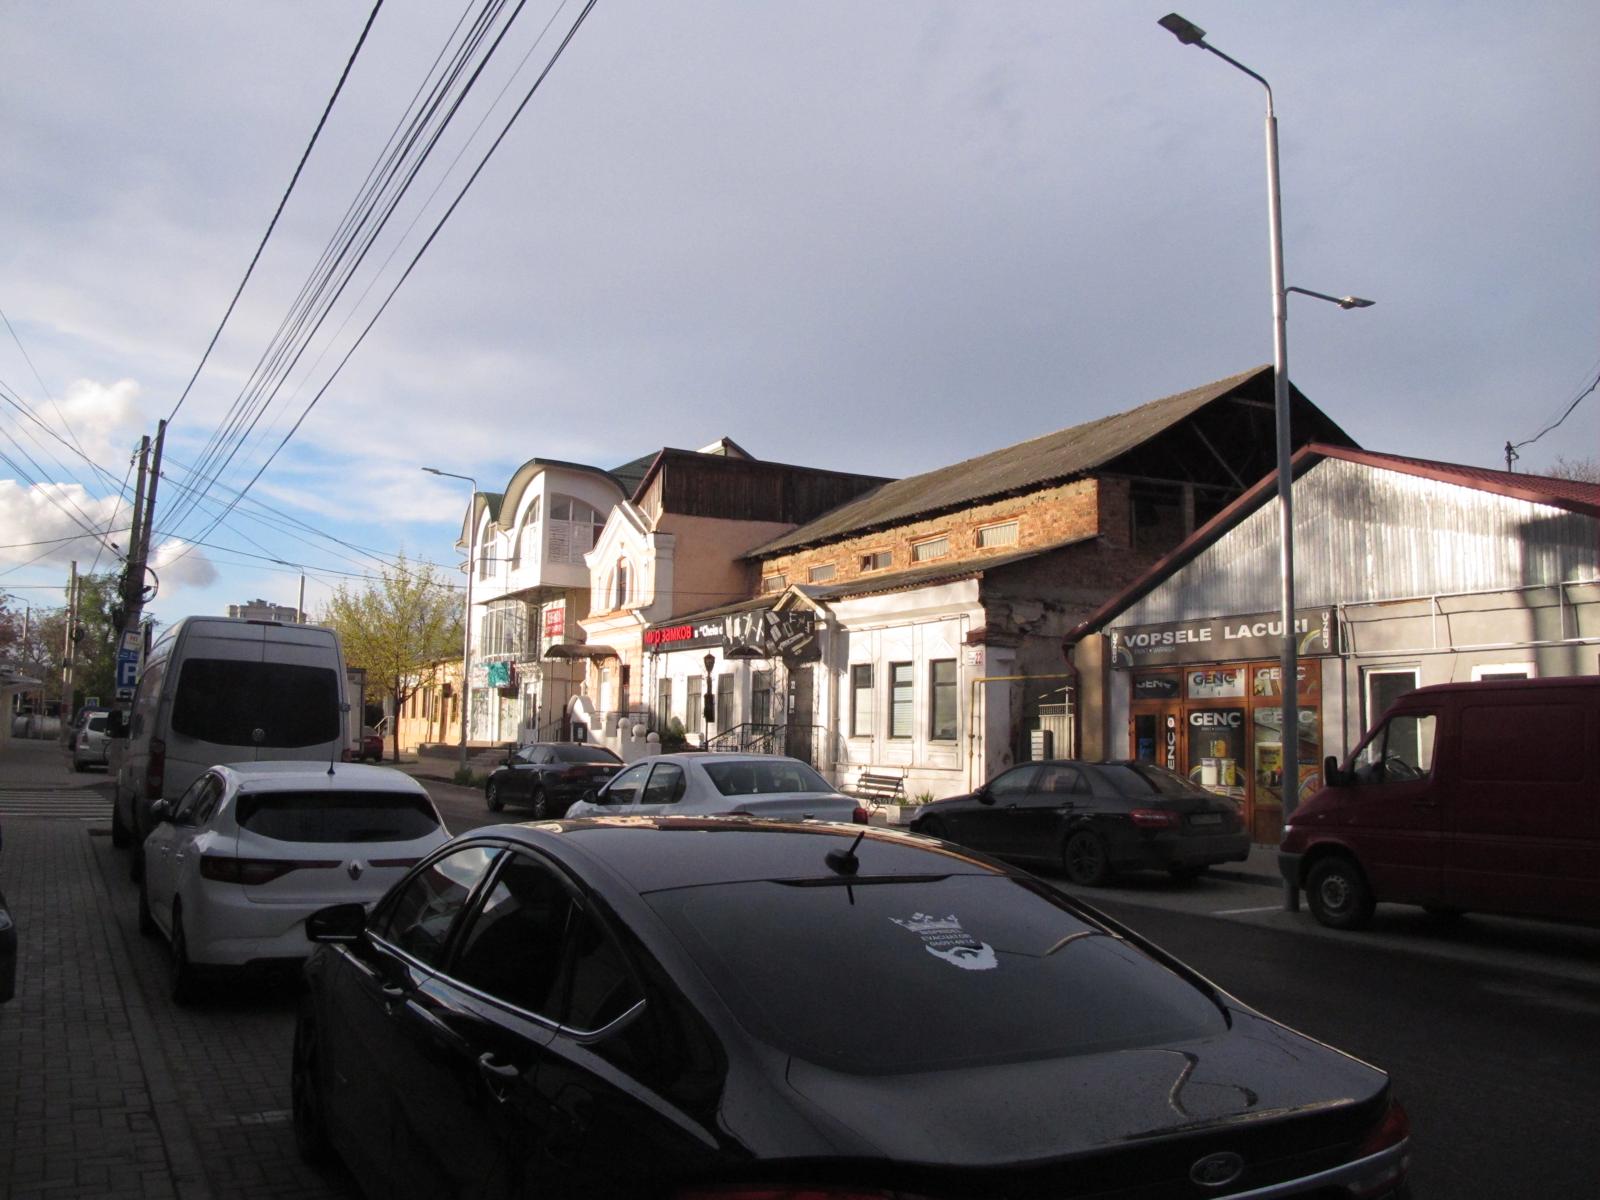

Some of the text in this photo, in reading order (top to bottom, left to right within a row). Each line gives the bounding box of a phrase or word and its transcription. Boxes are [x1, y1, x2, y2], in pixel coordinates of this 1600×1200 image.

[1124, 627, 1212, 648] VOPSELE
[1257, 666, 1306, 681] GEÇ
[1190, 711, 1241, 728] GENÇ
